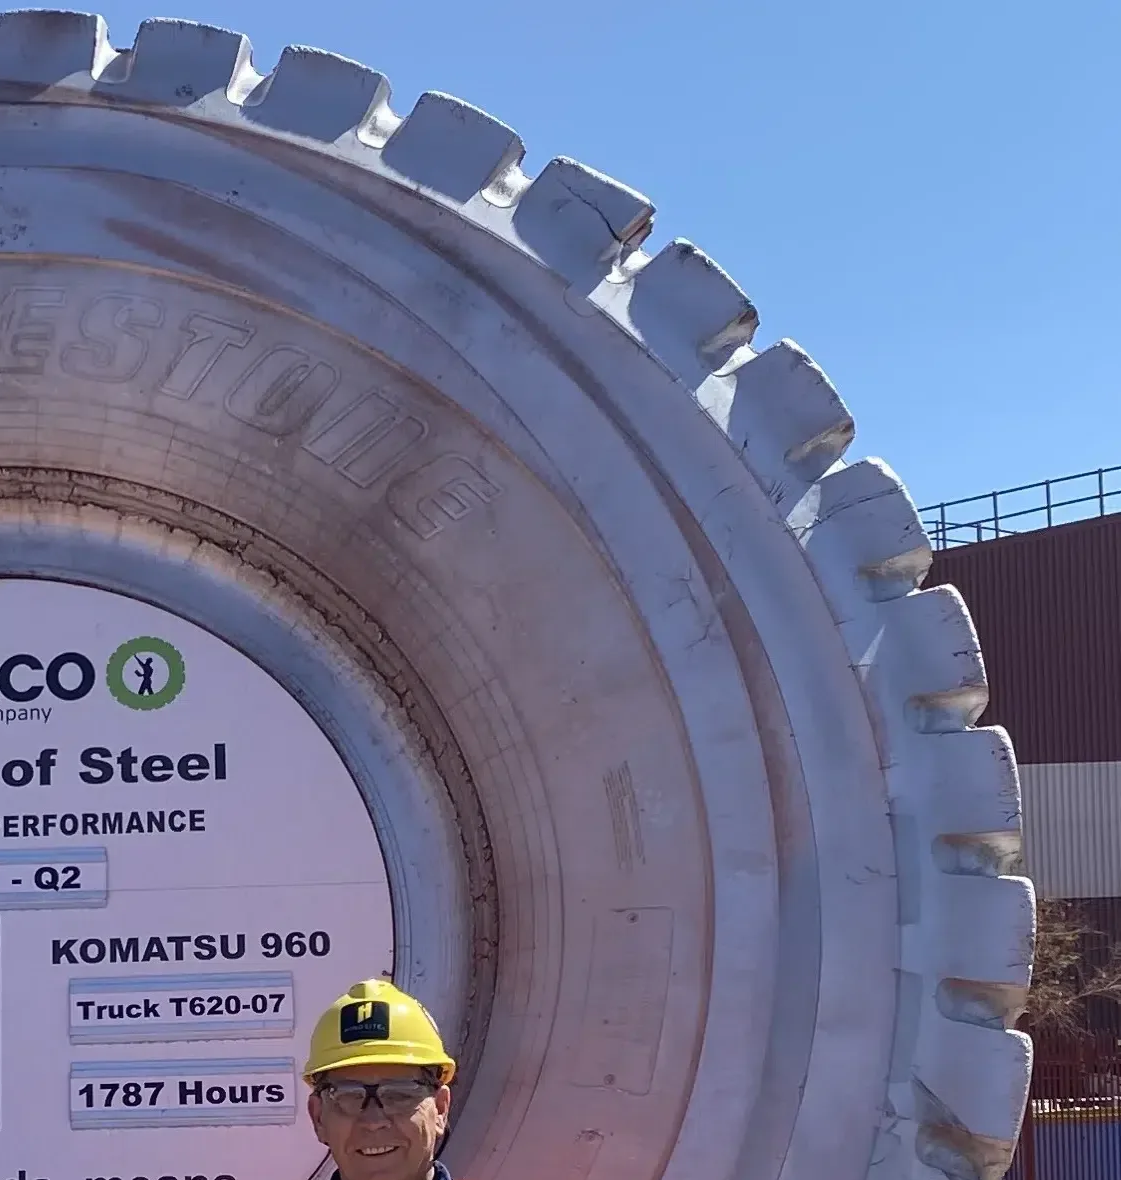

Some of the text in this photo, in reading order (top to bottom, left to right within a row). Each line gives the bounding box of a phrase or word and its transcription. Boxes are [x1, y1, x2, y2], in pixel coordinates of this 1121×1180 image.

[1, 748, 59, 787] of
[78, 743, 227, 785] Steel
[34, 865, 81, 892] Q2
[51, 930, 331, 965] KOMATSU 960
[76, 993, 286, 1021] Truck T620-07
[78, 1080, 285, 1109] 1787 Hours
